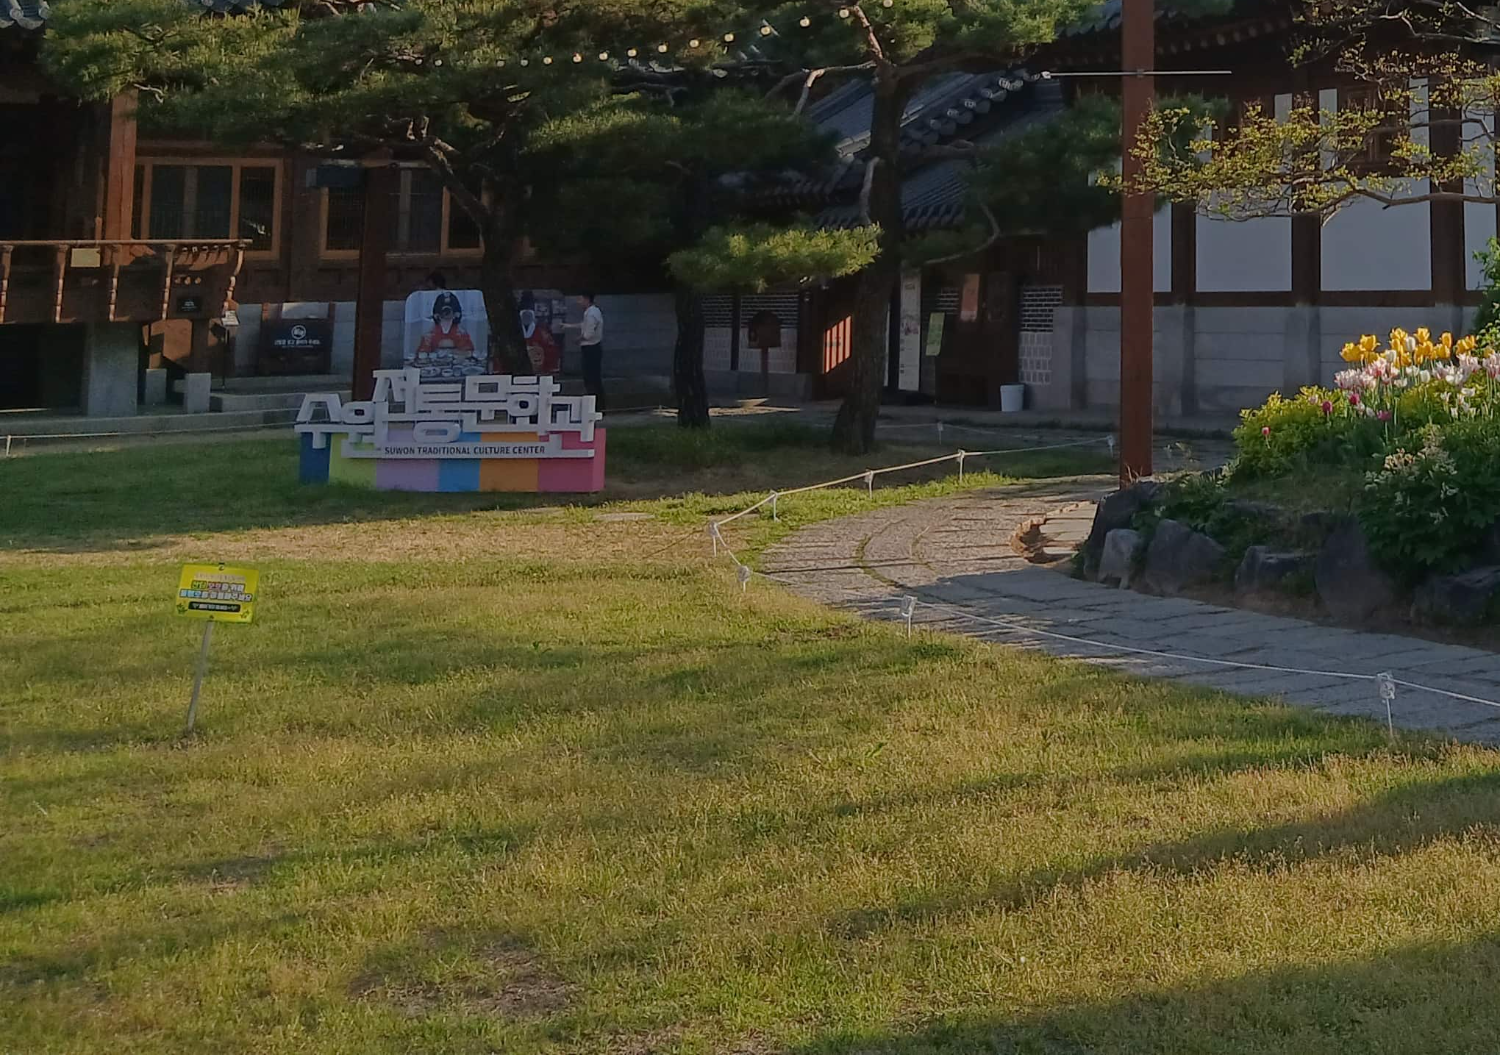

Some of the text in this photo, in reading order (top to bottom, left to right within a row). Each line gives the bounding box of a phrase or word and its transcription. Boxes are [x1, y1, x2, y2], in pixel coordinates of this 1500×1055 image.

[294, 367, 603, 458] 수원전통문화관
[384, 445, 545, 455] SUWON TRADITIONAL CULTURE CENTER
